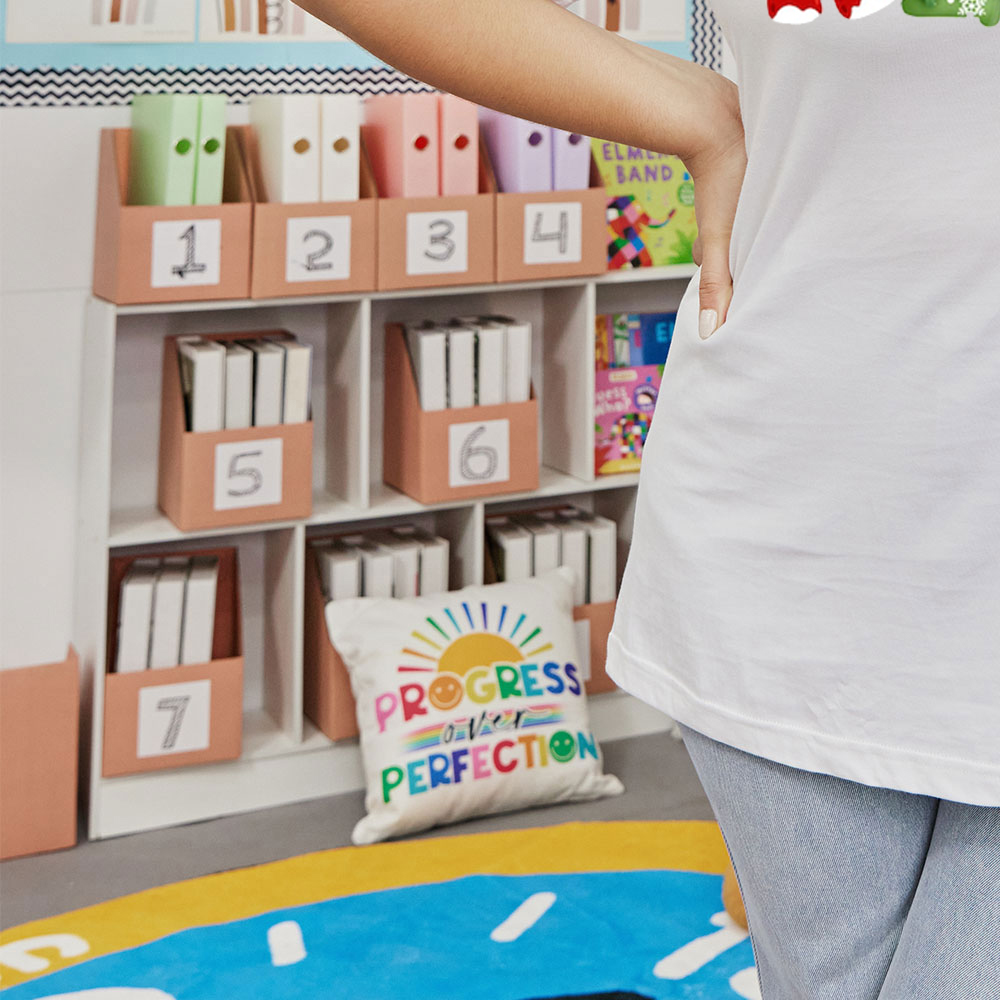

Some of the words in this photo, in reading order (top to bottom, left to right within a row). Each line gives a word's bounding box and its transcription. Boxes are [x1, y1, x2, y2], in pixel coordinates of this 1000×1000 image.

[616, 165, 673, 184] BAND
[172, 225, 206, 279] 1
[301, 230, 334, 271] 2
[425, 219, 456, 261] 3
[531, 212, 568, 254] 4
[228, 451, 263, 497] 5
[460, 426, 497, 482] 6
[156, 695, 191, 750] 7
[375, 662, 582, 733] PROGRESS
[443, 708, 529, 743] over
[382, 731, 599, 804] PERFECTION
